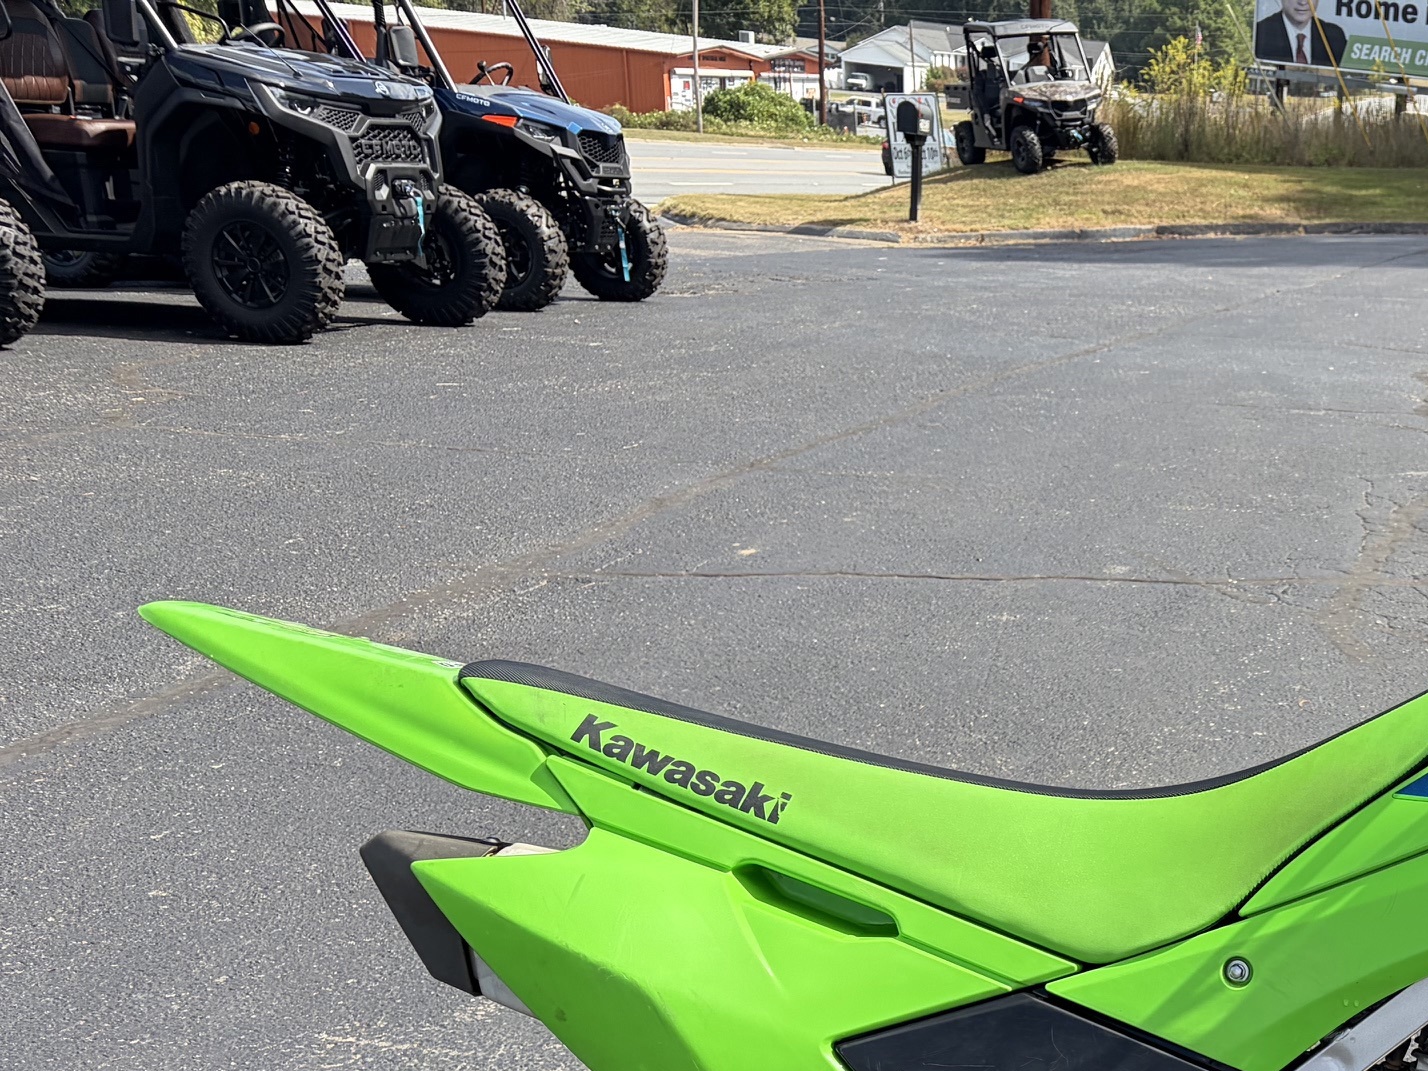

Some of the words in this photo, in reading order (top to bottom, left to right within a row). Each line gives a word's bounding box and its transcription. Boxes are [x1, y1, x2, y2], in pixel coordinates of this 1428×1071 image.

[1350, 42, 1412, 64] SEARCH
[456, 93, 490, 107] CFMOTO
[362, 140, 421, 156] CFMOTO
[570, 713, 793, 824] Kawasaki
